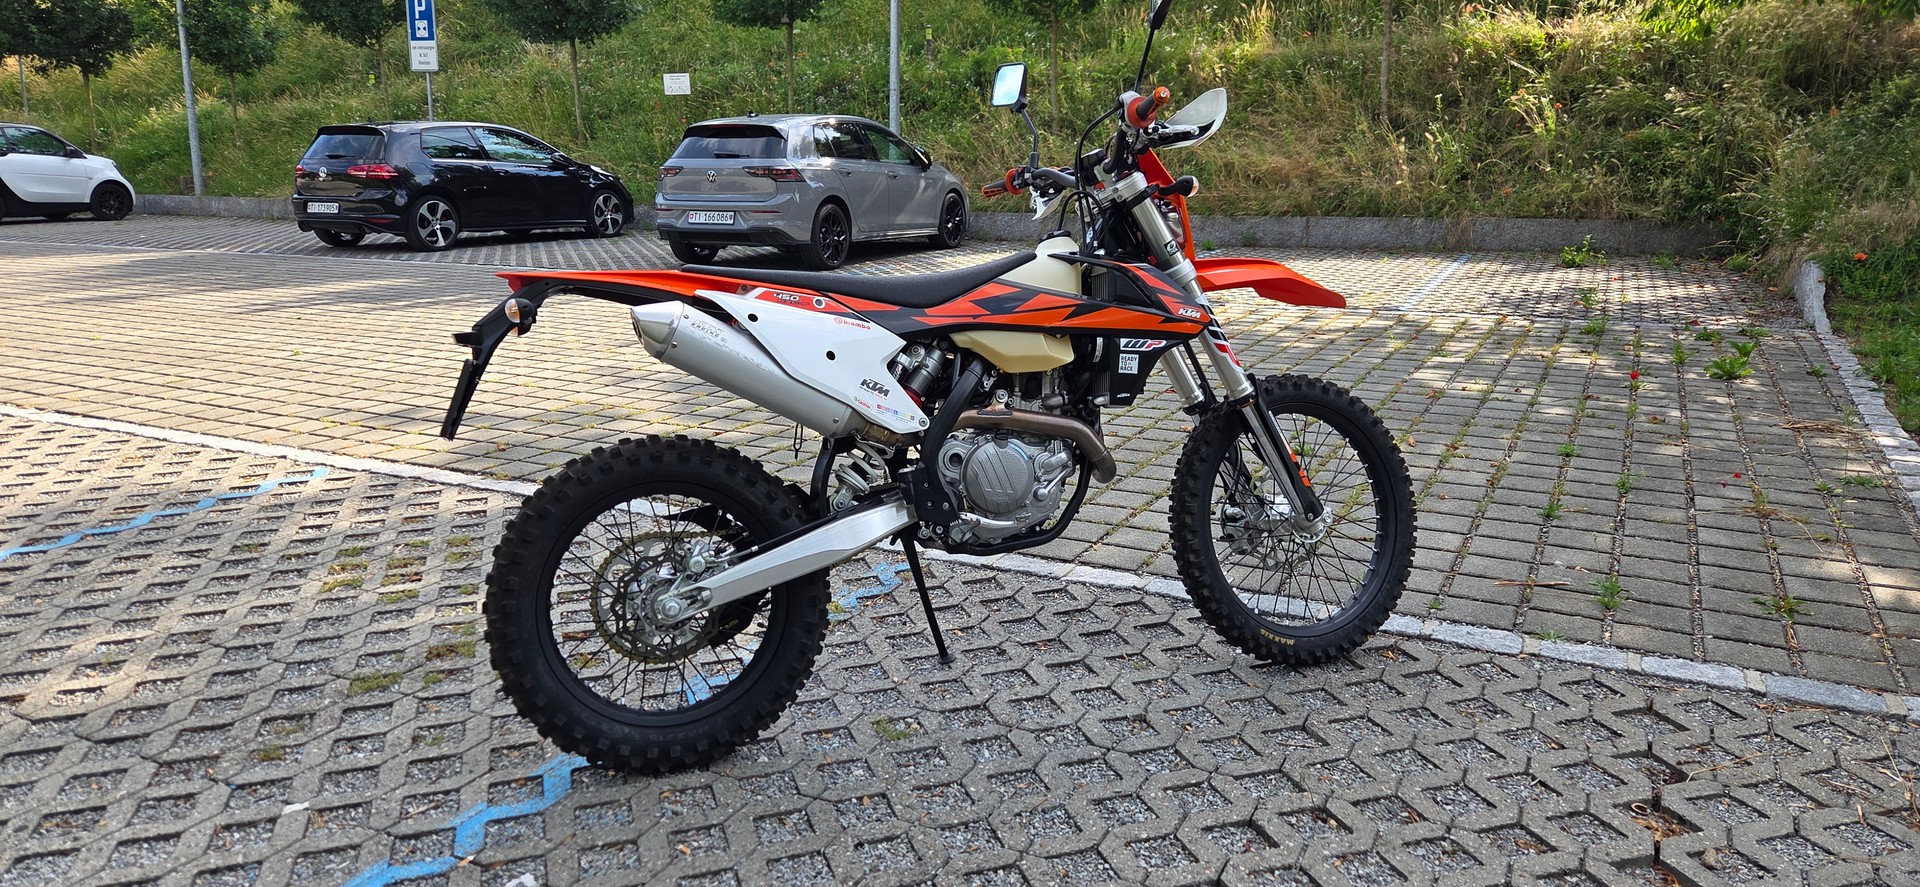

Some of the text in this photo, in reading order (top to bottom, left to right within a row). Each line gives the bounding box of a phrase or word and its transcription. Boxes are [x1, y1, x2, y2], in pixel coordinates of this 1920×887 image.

[705, 213, 729, 222] 166086
[773, 293, 800, 301] 450
[1178, 308, 1201, 319] KTM
[843, 319, 871, 330] brembo
[1122, 340, 1163, 349] WP
[860, 378, 890, 397] KTM
[1260, 629, 1294, 646] MAXXIS
